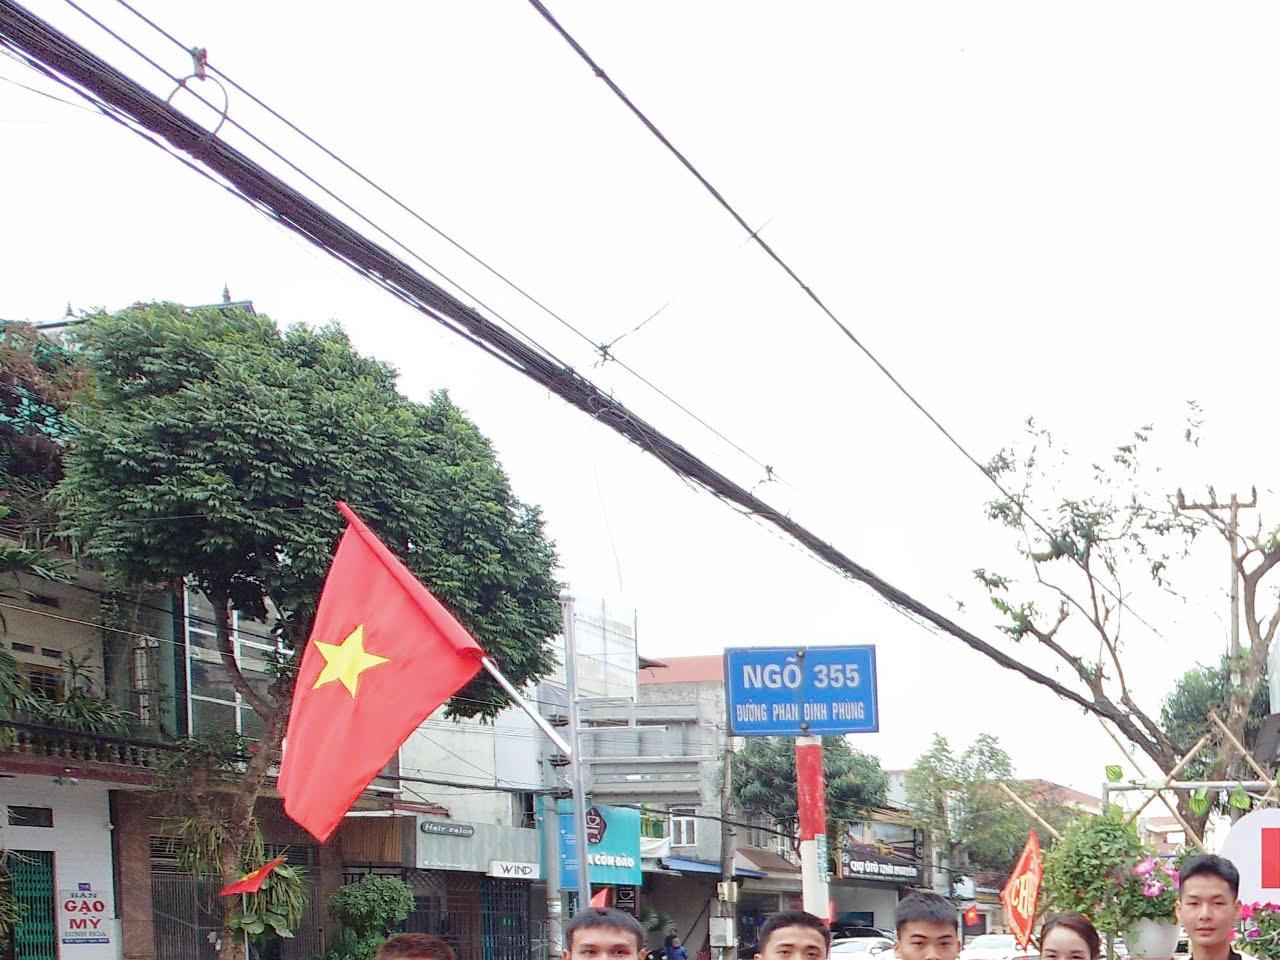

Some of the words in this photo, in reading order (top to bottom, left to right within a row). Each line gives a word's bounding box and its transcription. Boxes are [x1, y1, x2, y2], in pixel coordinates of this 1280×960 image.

[743, 656, 801, 688] NGÕ
[813, 664, 860, 688] 355
[736, 700, 767, 722] ĐƯỜNG
[772, 703, 799, 721] PHAN
[803, 699, 827, 720] ĐÌNH
[832, 699, 864, 720] PHÙNG
[424, 823, 446, 832] Hair
[448, 827, 474, 836] salon
[501, 864, 533, 875] WIND
[64, 900, 105, 915] GẠO
